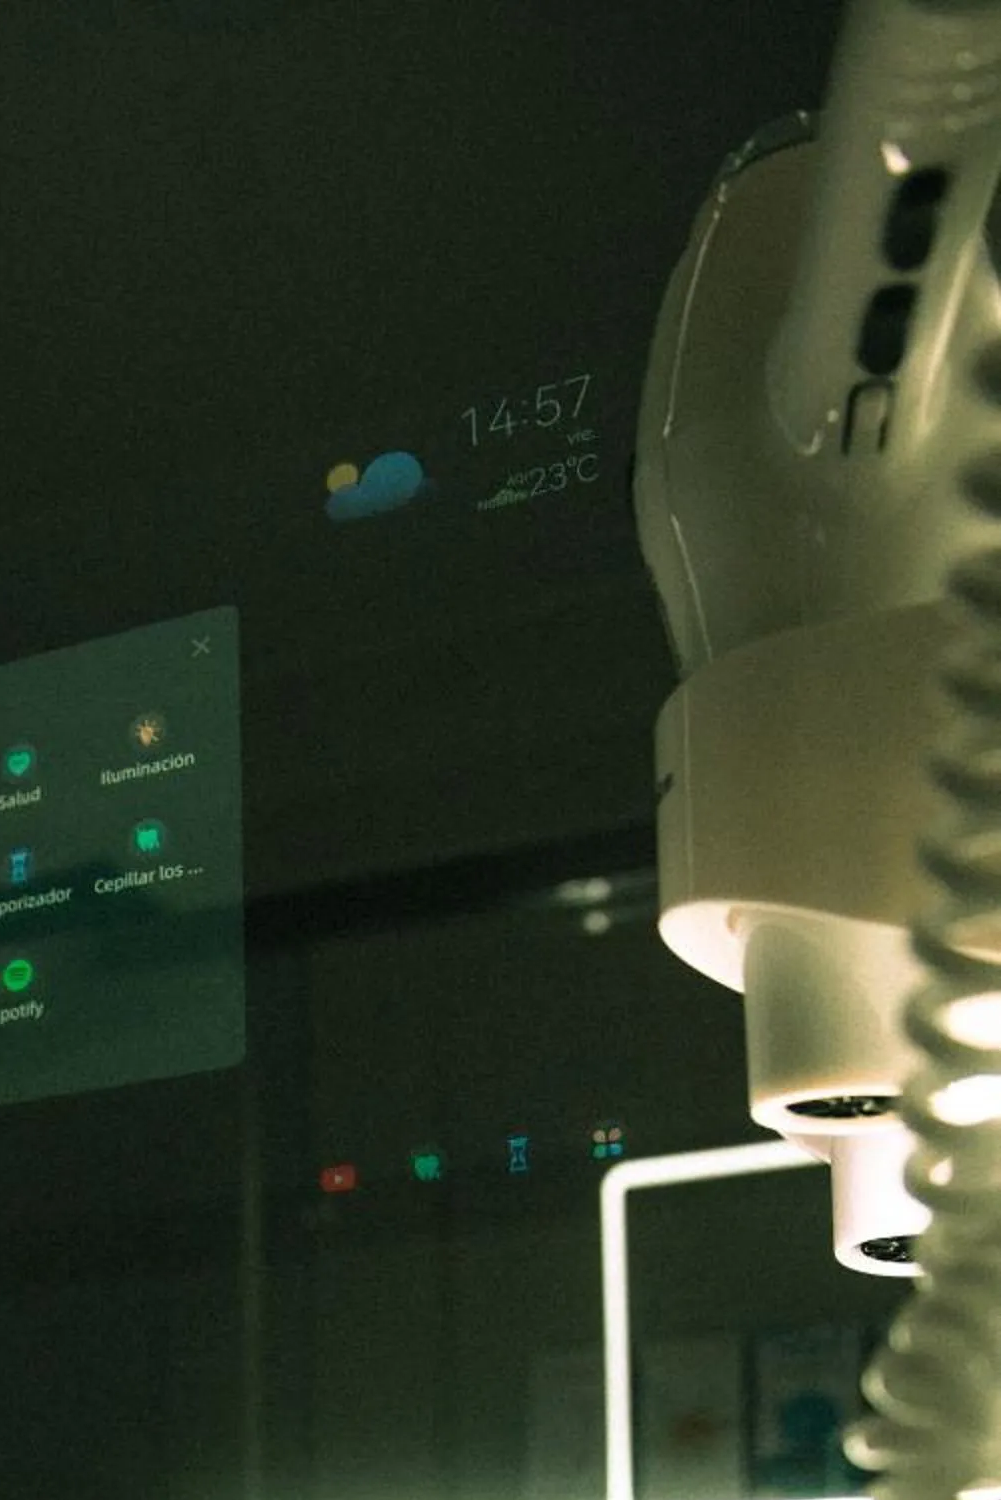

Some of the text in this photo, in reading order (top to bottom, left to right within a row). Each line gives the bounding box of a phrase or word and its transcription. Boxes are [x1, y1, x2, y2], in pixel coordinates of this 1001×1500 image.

[460, 372, 594, 447] 14:57
[100, 752, 196, 785] Iluminación
[94, 868, 156, 896] Cepillar
[159, 864, 184, 880] los
